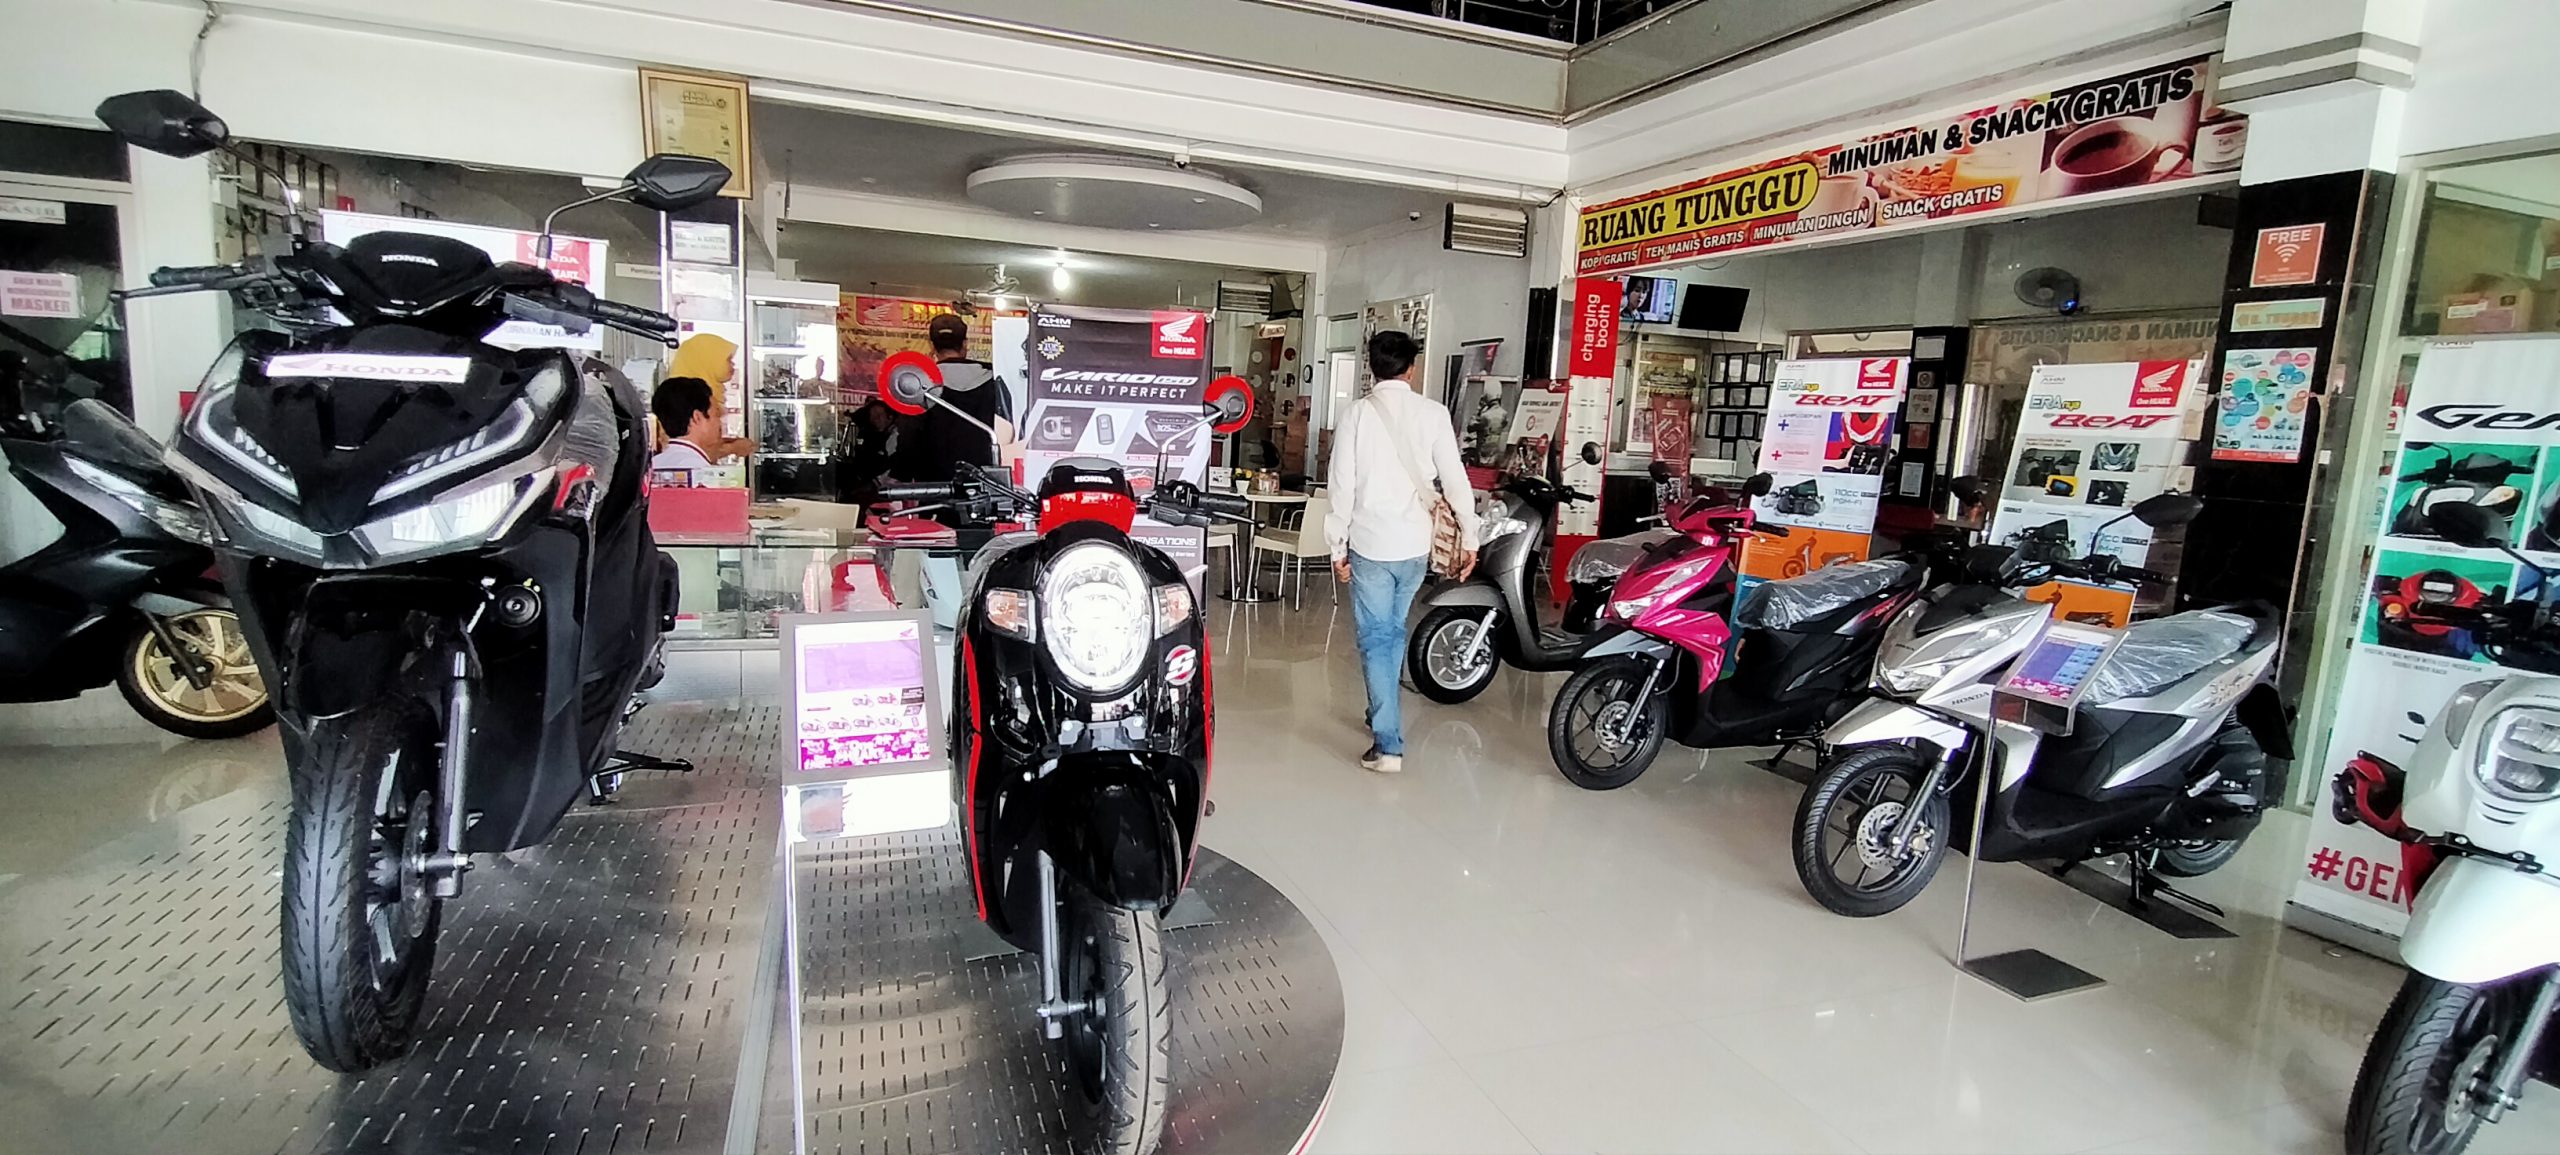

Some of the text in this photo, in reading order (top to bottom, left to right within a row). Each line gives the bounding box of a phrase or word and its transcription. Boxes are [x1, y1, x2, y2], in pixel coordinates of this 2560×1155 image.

[1828, 67, 2196, 177] MINUMAN & SNACK GRATIS
[1582, 168, 1808, 247] RUANG TUNGGU
[1581, 183, 2004, 269] KOPI GRATIS TEH MANIS GRATIS MINUMAN DINGIN SNACK GRATIS
[2267, 229, 2312, 245] FREE
[381, 254, 439, 267] HONDA
[1038, 317, 1072, 325] AHM
[1581, 294, 1600, 361] charging
[1595, 304, 1611, 348] booth
[324, 363, 456, 376] HONDA
[1040, 367, 1153, 384] VARIO
[1051, 382, 1187, 399] MAKE IT PERFECT
[1074, 475, 1114, 484] HONDA
[1951, 690, 1991, 706] HONDA
